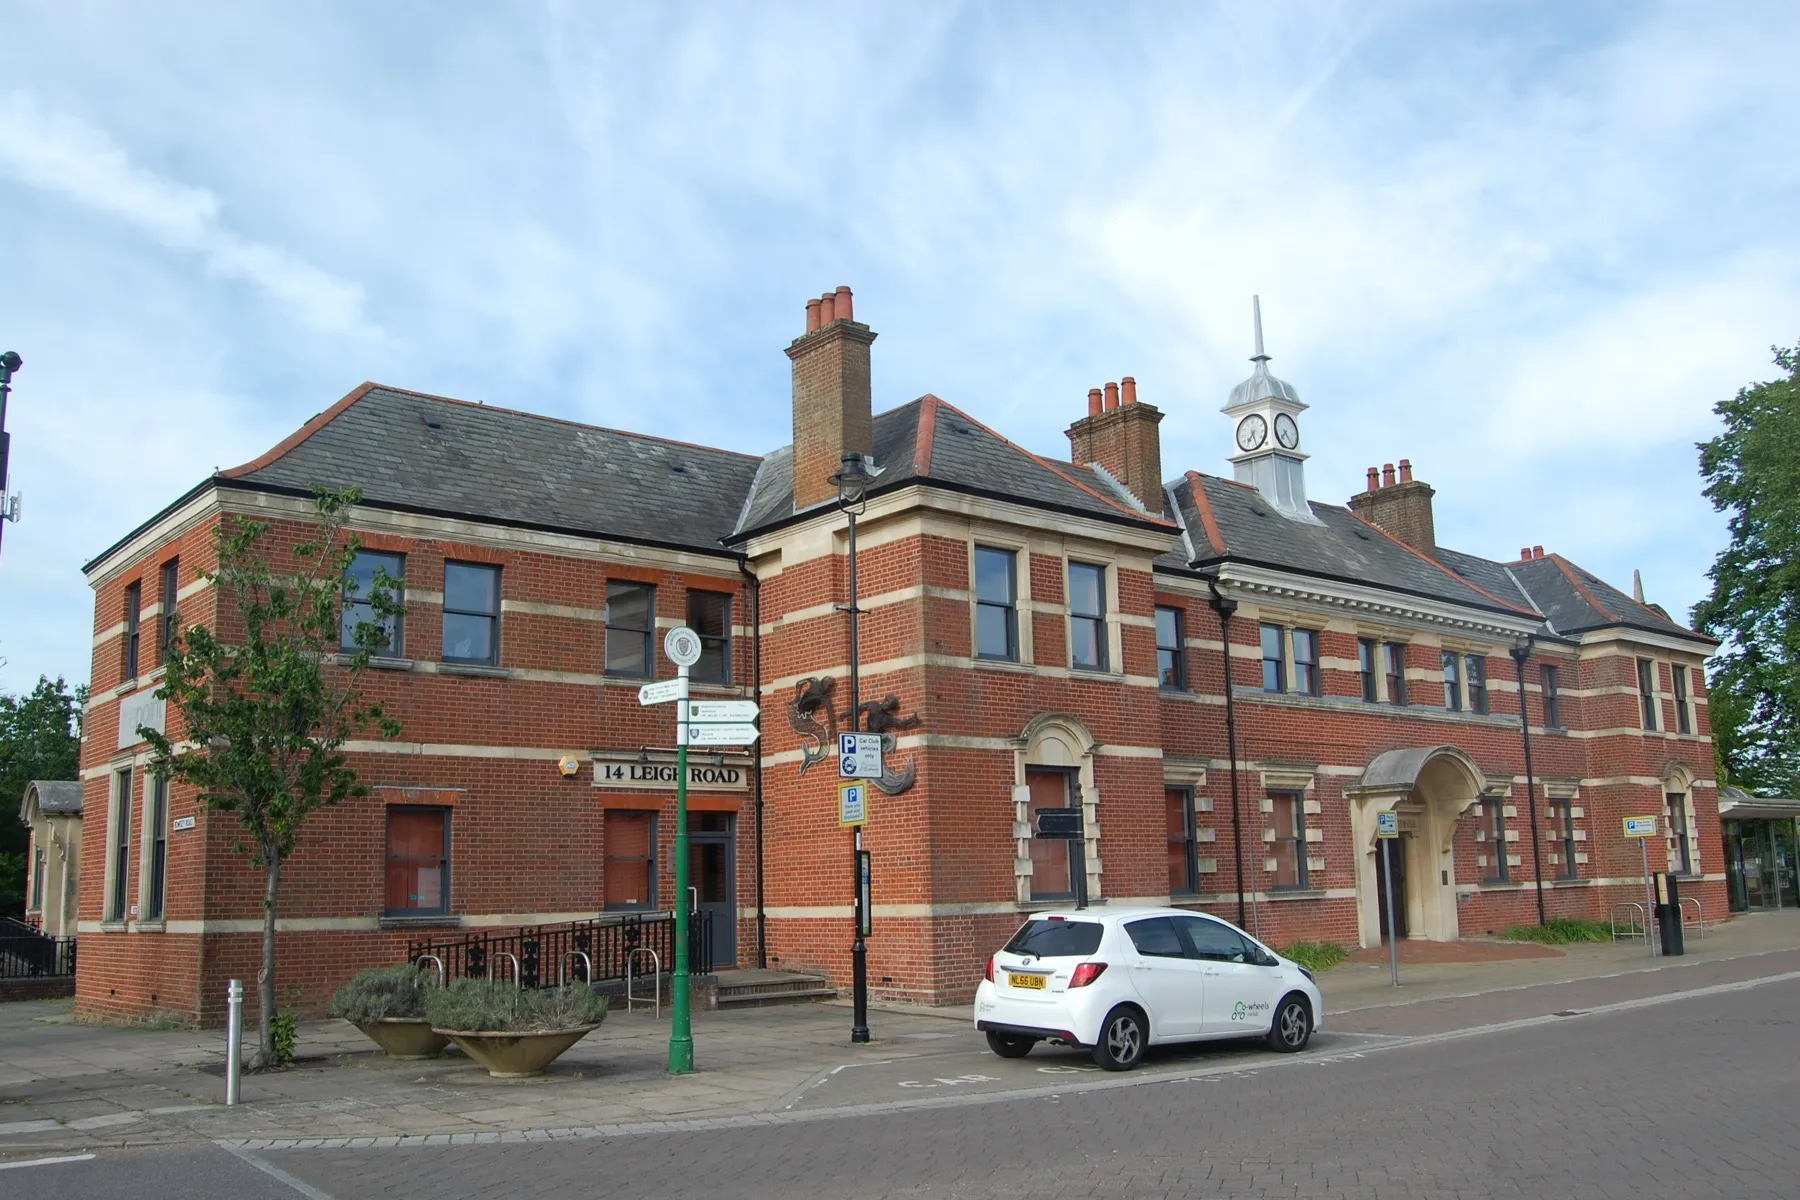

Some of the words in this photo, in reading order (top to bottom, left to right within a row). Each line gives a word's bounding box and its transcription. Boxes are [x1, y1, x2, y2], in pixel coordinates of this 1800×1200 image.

[844, 736, 855, 753] P
[605, 765, 624, 780] 14
[691, 768, 740, 783] ROAD
[1029, 976, 1044, 987] UBN
[898, 1074, 1001, 1088] CAR
